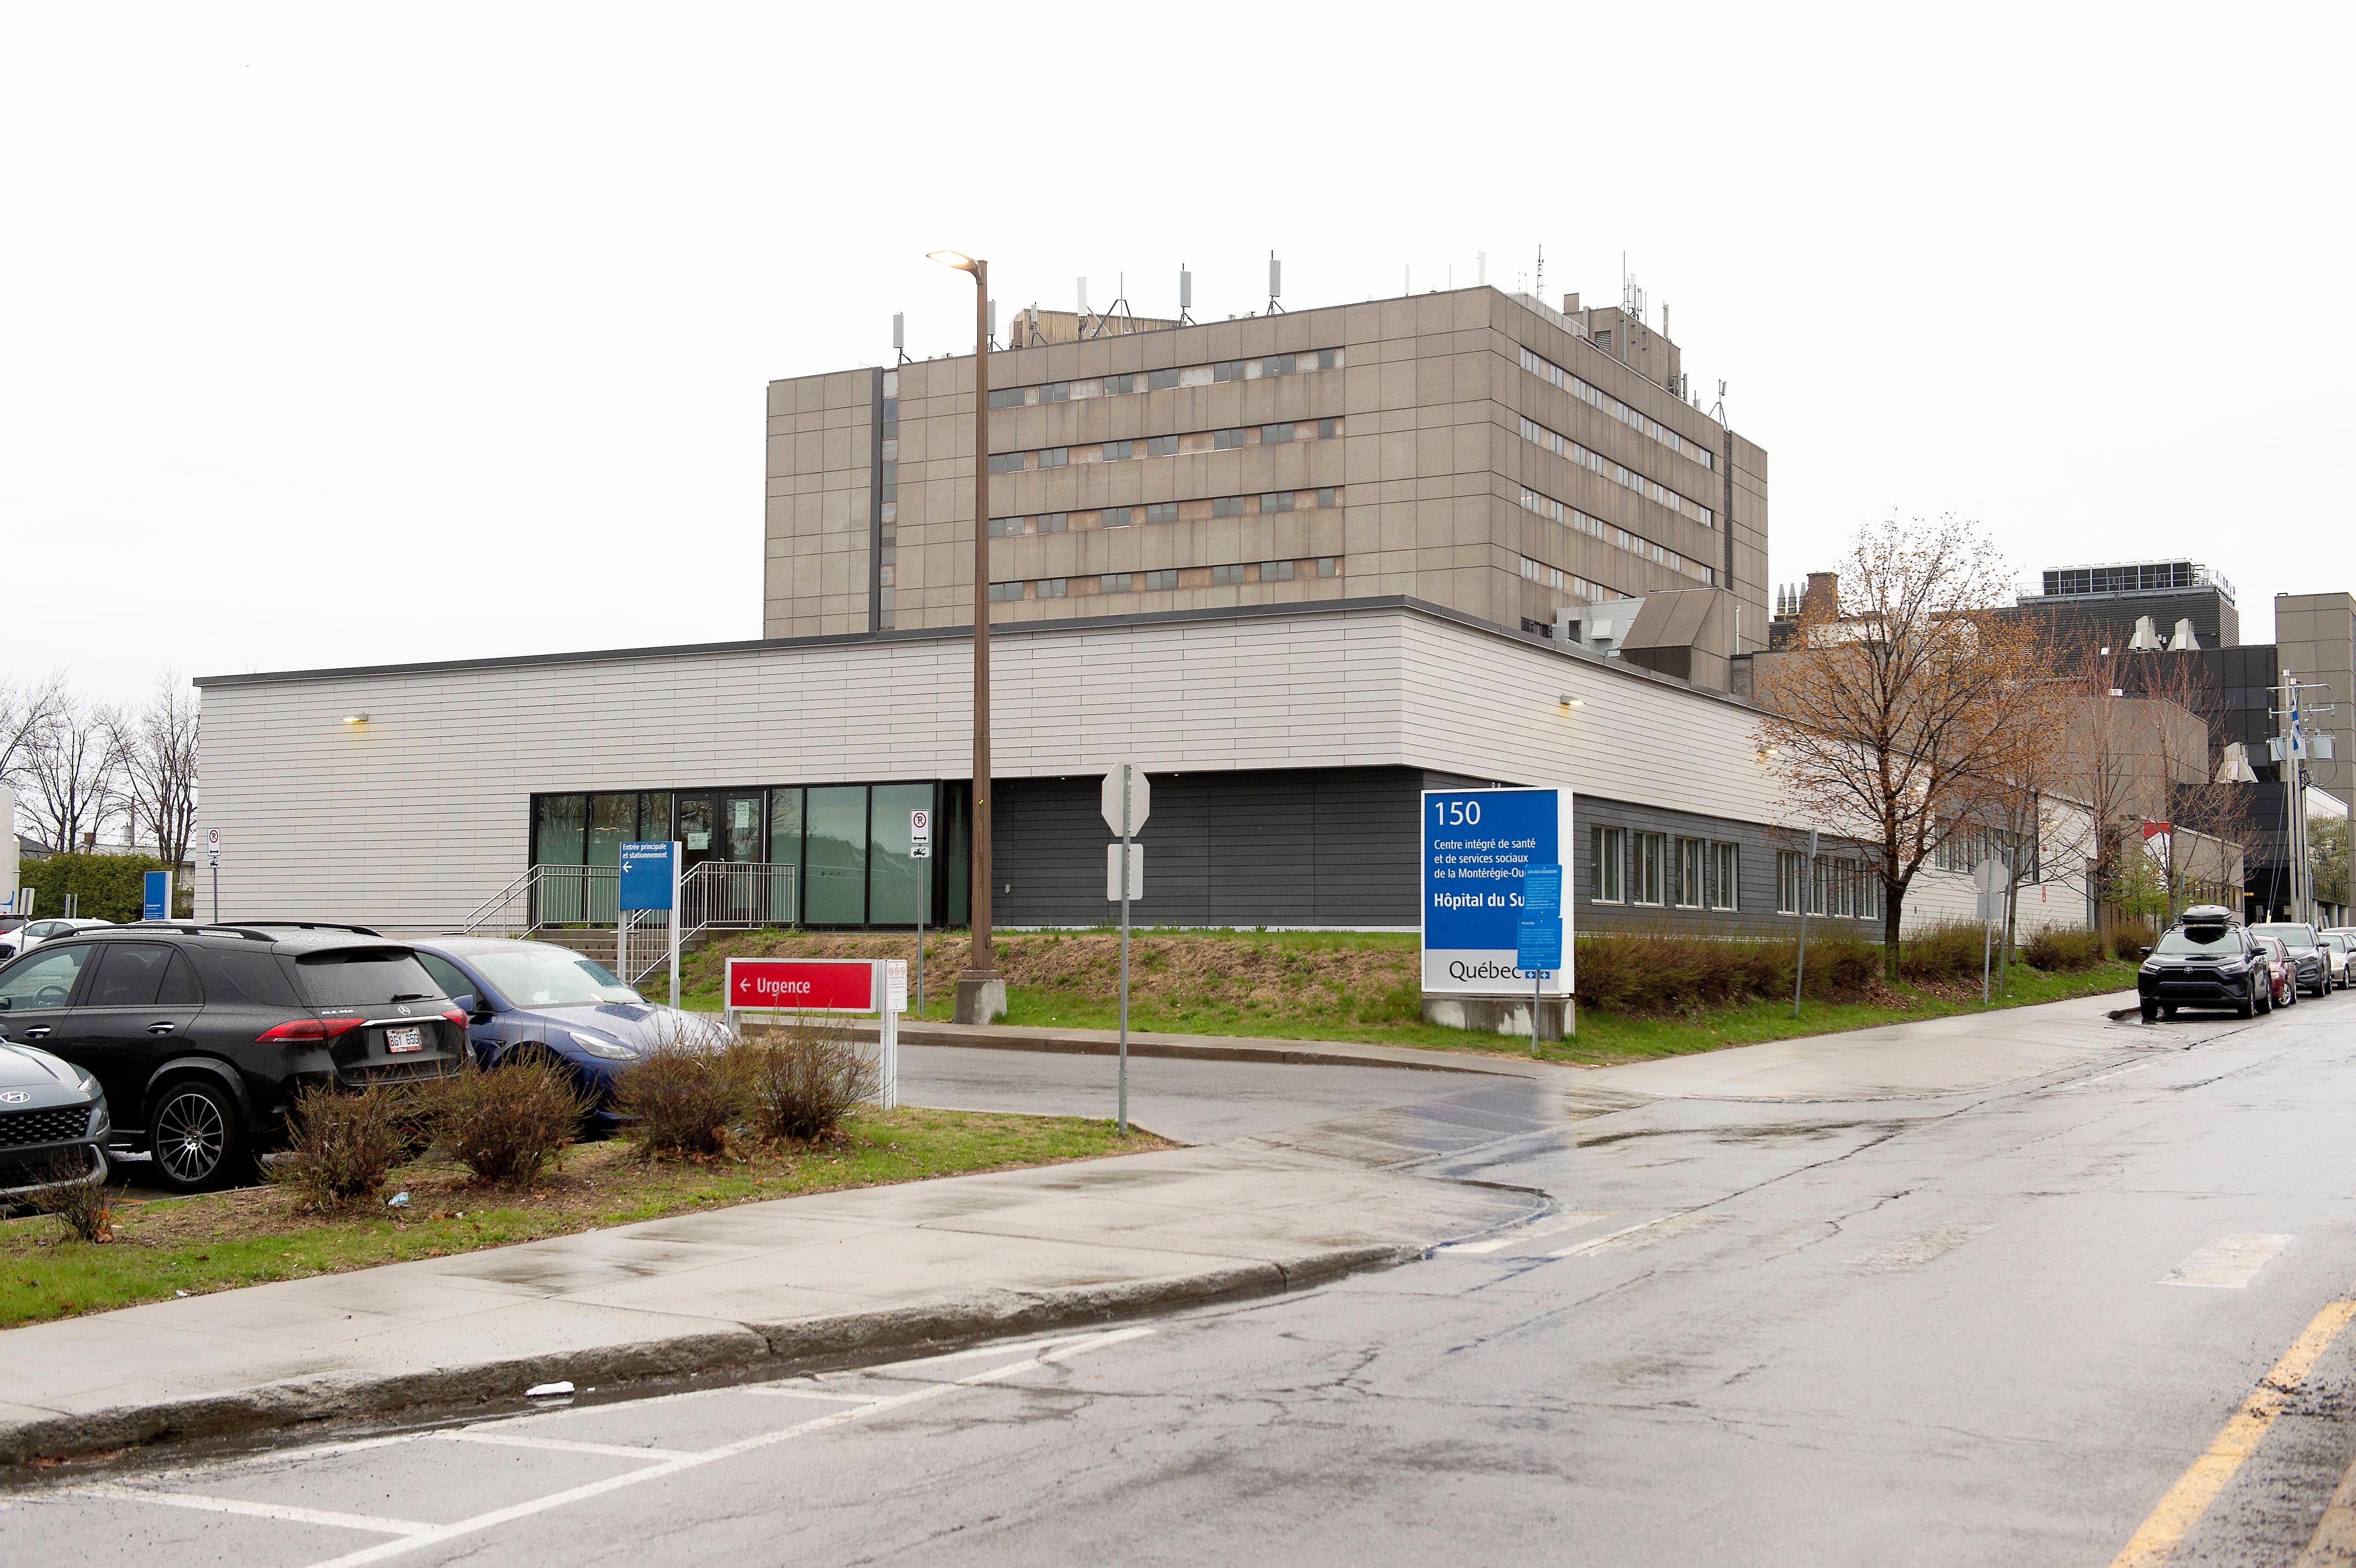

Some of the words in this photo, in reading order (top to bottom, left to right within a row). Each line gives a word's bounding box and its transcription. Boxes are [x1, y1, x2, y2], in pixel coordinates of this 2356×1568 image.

[1436, 801, 1480, 825] 150
[641, 843, 666, 851] principale
[1434, 840, 1462, 849] Centre
[1465, 838, 1495, 851] intégré
[1498, 839, 1508, 848] de
[1512, 838, 1536, 848] santé
[1434, 854, 1443, 863] et
[1446, 854, 1456, 863] de
[1459, 853, 1493, 863] services
[1495, 853, 1528, 862] sociaux
[1434, 869, 1445, 878] de
[1448, 869, 1455, 878] la
[1459, 866, 1526, 880] Montérégie-Ou
[1435, 893, 1483, 910] Hôpital
[1488, 893, 1505, 906] du
[1510, 893, 1524, 906] Su
[1450, 960, 1521, 981] Québec
[757, 978, 810, 996] Urgence
